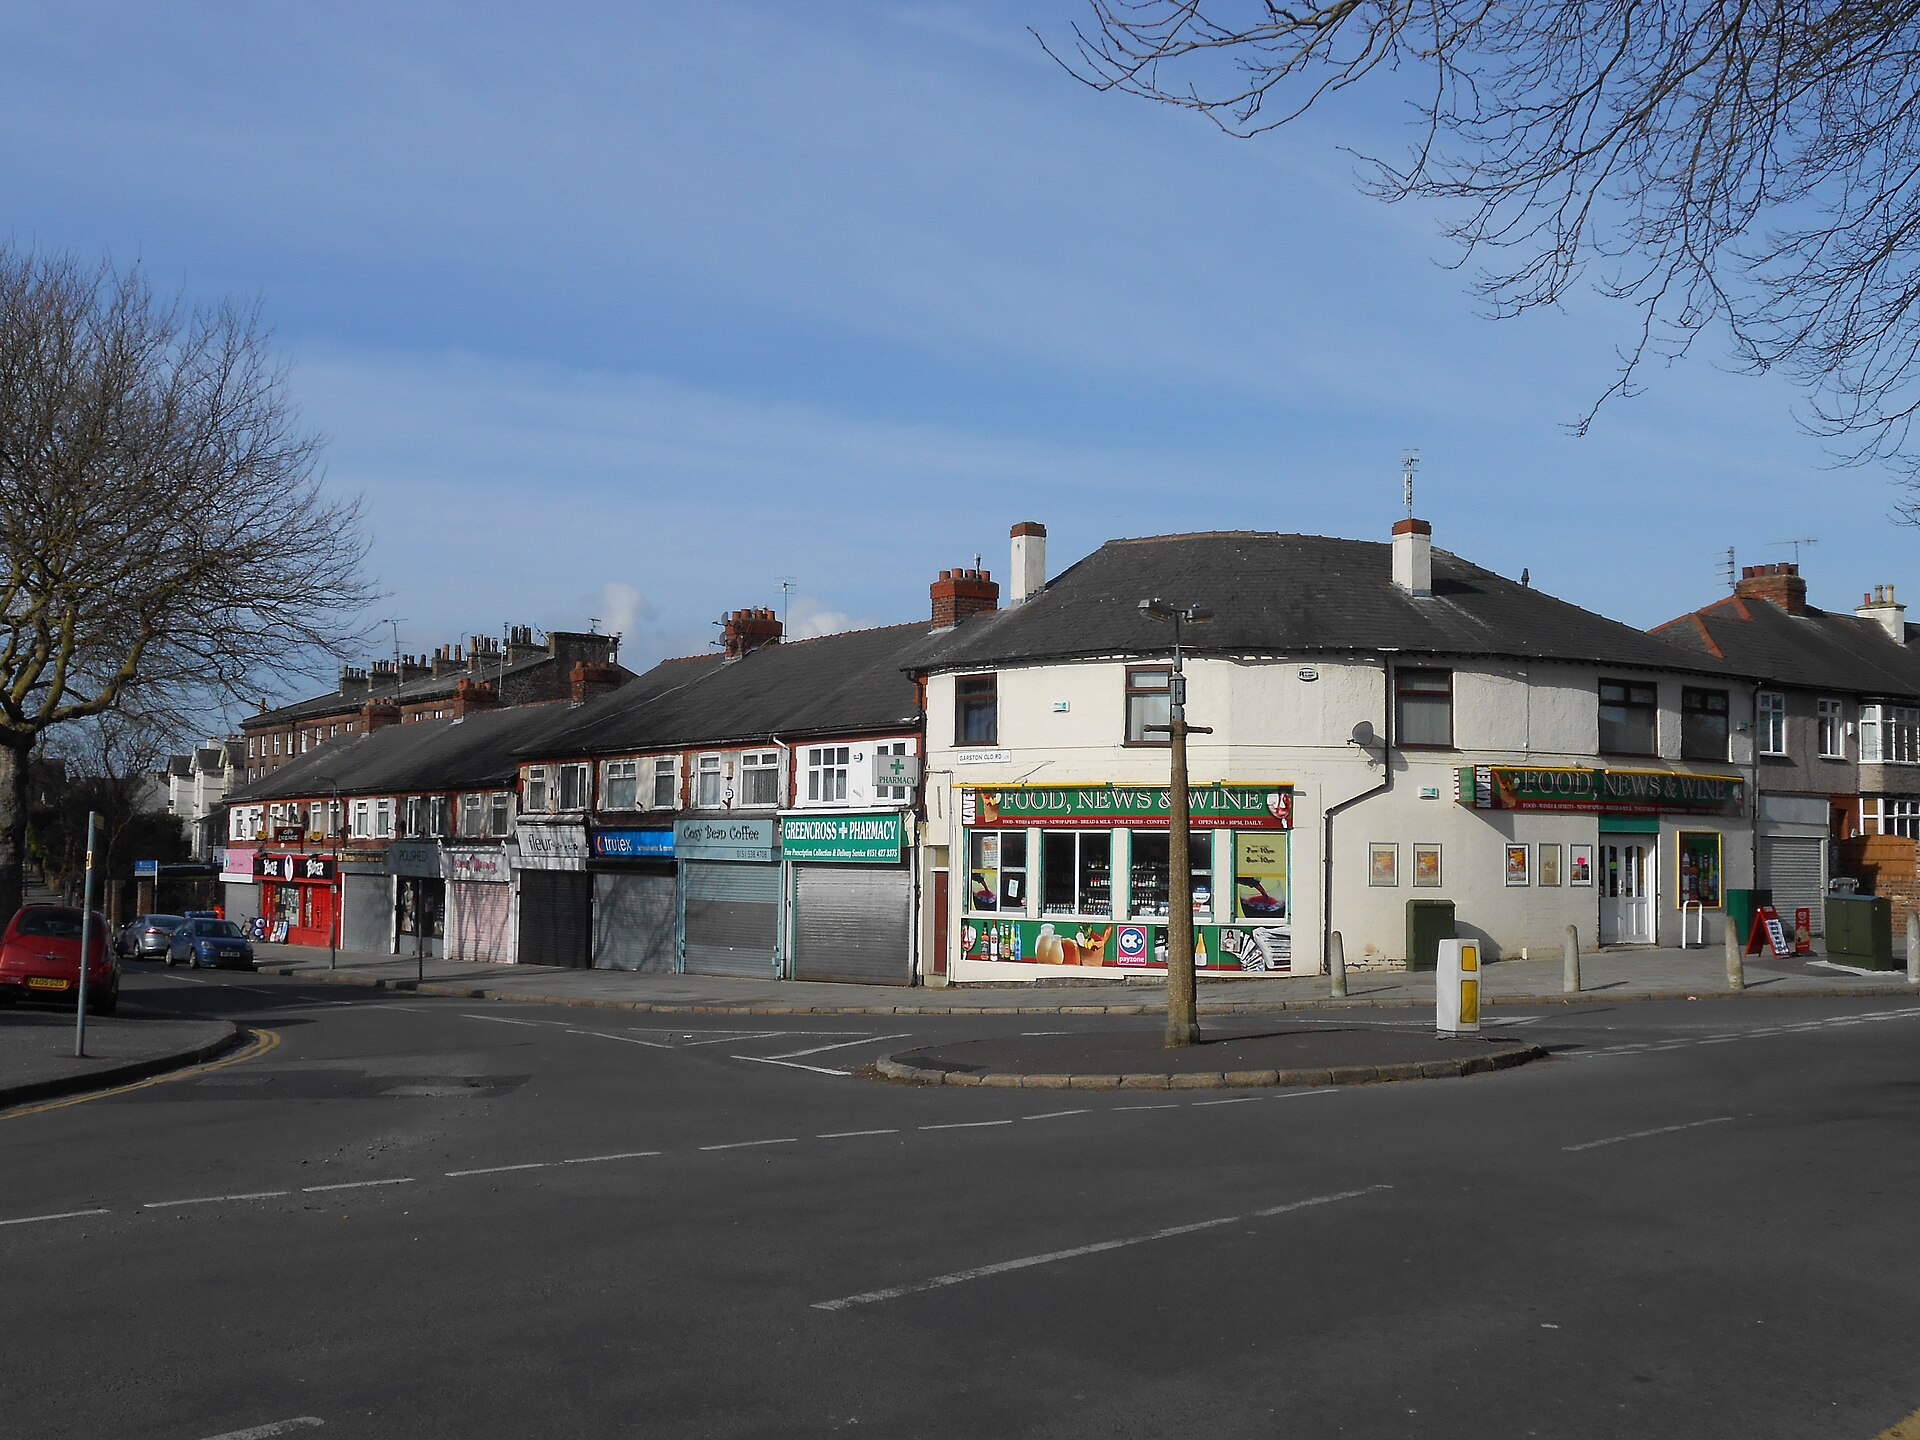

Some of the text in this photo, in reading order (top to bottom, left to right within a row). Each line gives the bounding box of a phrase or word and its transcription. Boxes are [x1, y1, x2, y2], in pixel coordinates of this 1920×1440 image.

[880, 776, 916, 784] PHARMACY
[1522, 771, 1727, 801] FOOD, NEWS & WINE
[1003, 788, 1263, 815] FOOD, NEWS & WINE
[705, 825, 727, 840] Bean
[730, 825, 759, 840] Coffee
[785, 820, 897, 841] GREENCROSS PHARMACY
[529, 833, 551, 852] fleur
[604, 837, 632, 851] trutex
